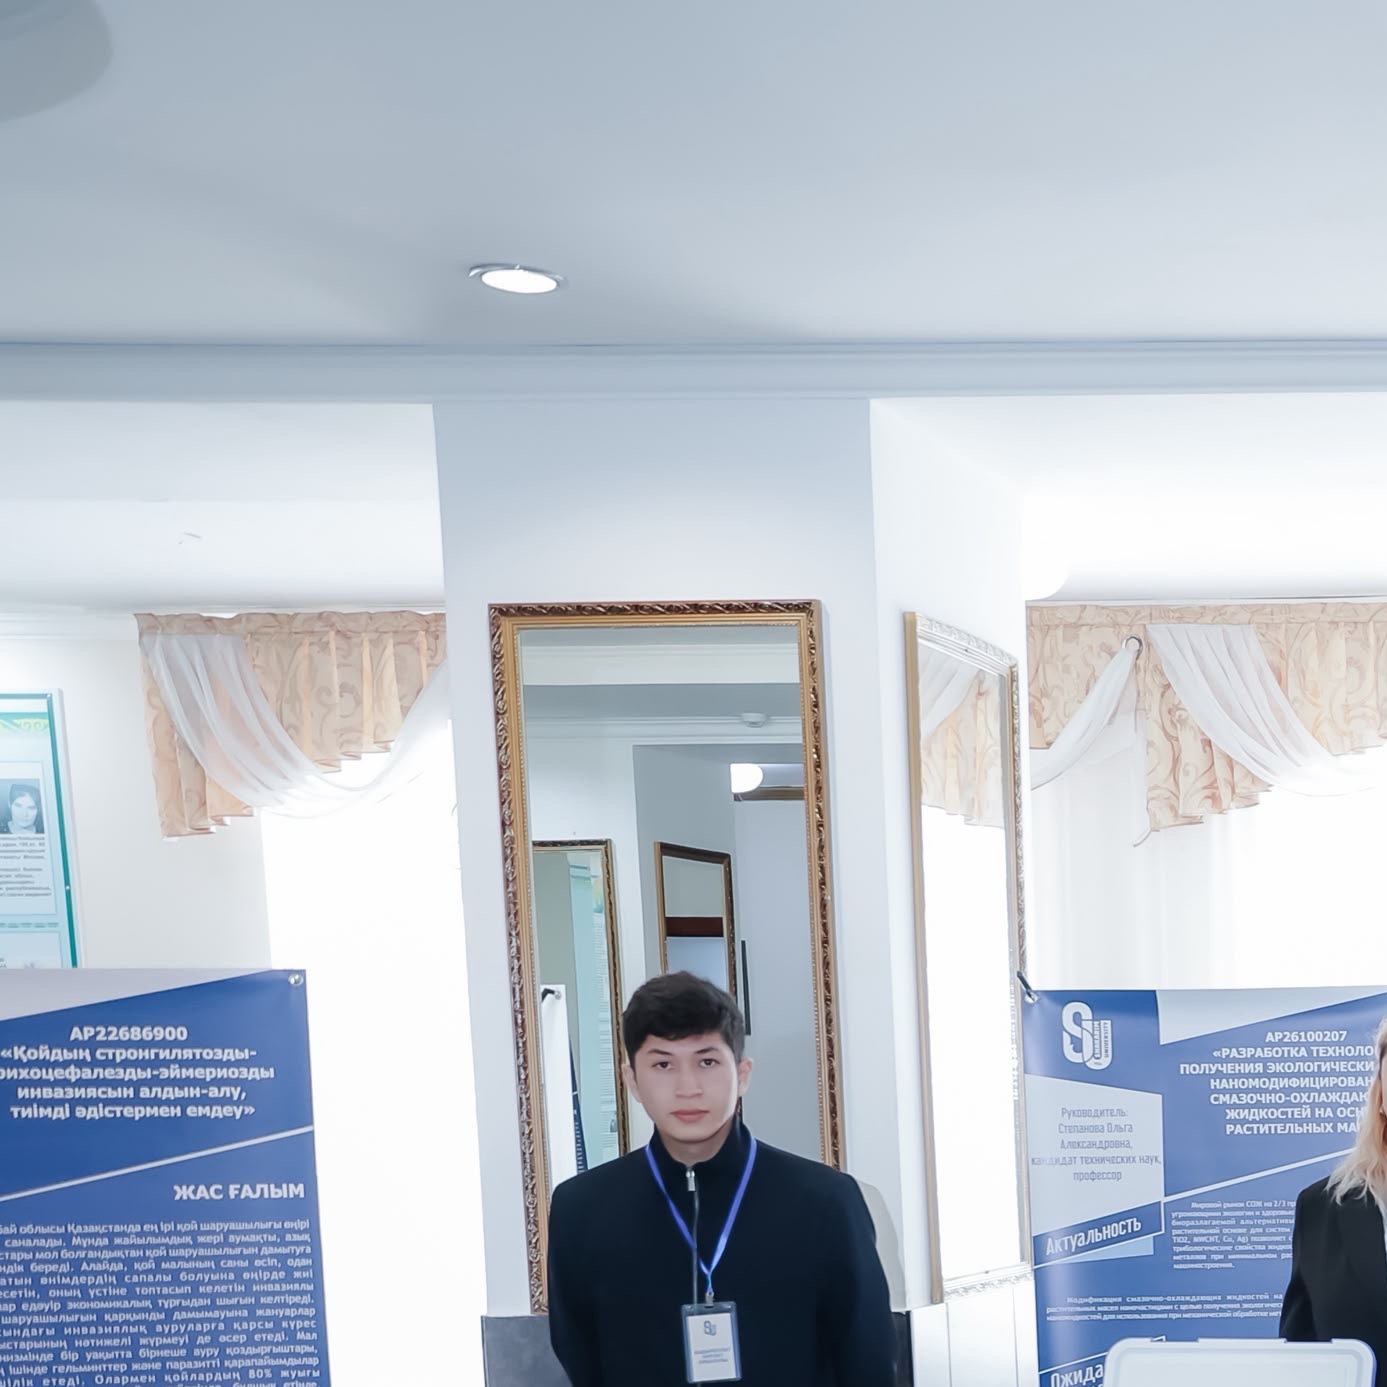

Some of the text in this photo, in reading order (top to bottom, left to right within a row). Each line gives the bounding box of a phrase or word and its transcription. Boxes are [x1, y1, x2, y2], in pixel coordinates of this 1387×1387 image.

[69, 1026, 188, 1041] AP22686900
[1, 1045, 256, 1063] «Қойдың стронгилятозды-
[1310, 1046, 1374, 1057] ТЕХНОЛО
[1210, 1076, 1373, 1090] НАНОМОДИФИЦИРОВАН
[17, 1086, 246, 1100] инвазиясын алдын-алу,
[1210, 1092, 1368, 1105] СМАЗОЧНО-ОХЛАЖДА
[9, 1102, 255, 1120] тиімді әдістермен емдеу»
[1336, 1107, 1363, 1118] ОСН
[1225, 1122, 1333, 1134] РАСТИТЕЛЬНЫХ
[173, 1183, 304, 1200] ЖАС ҒАЛЫМ
